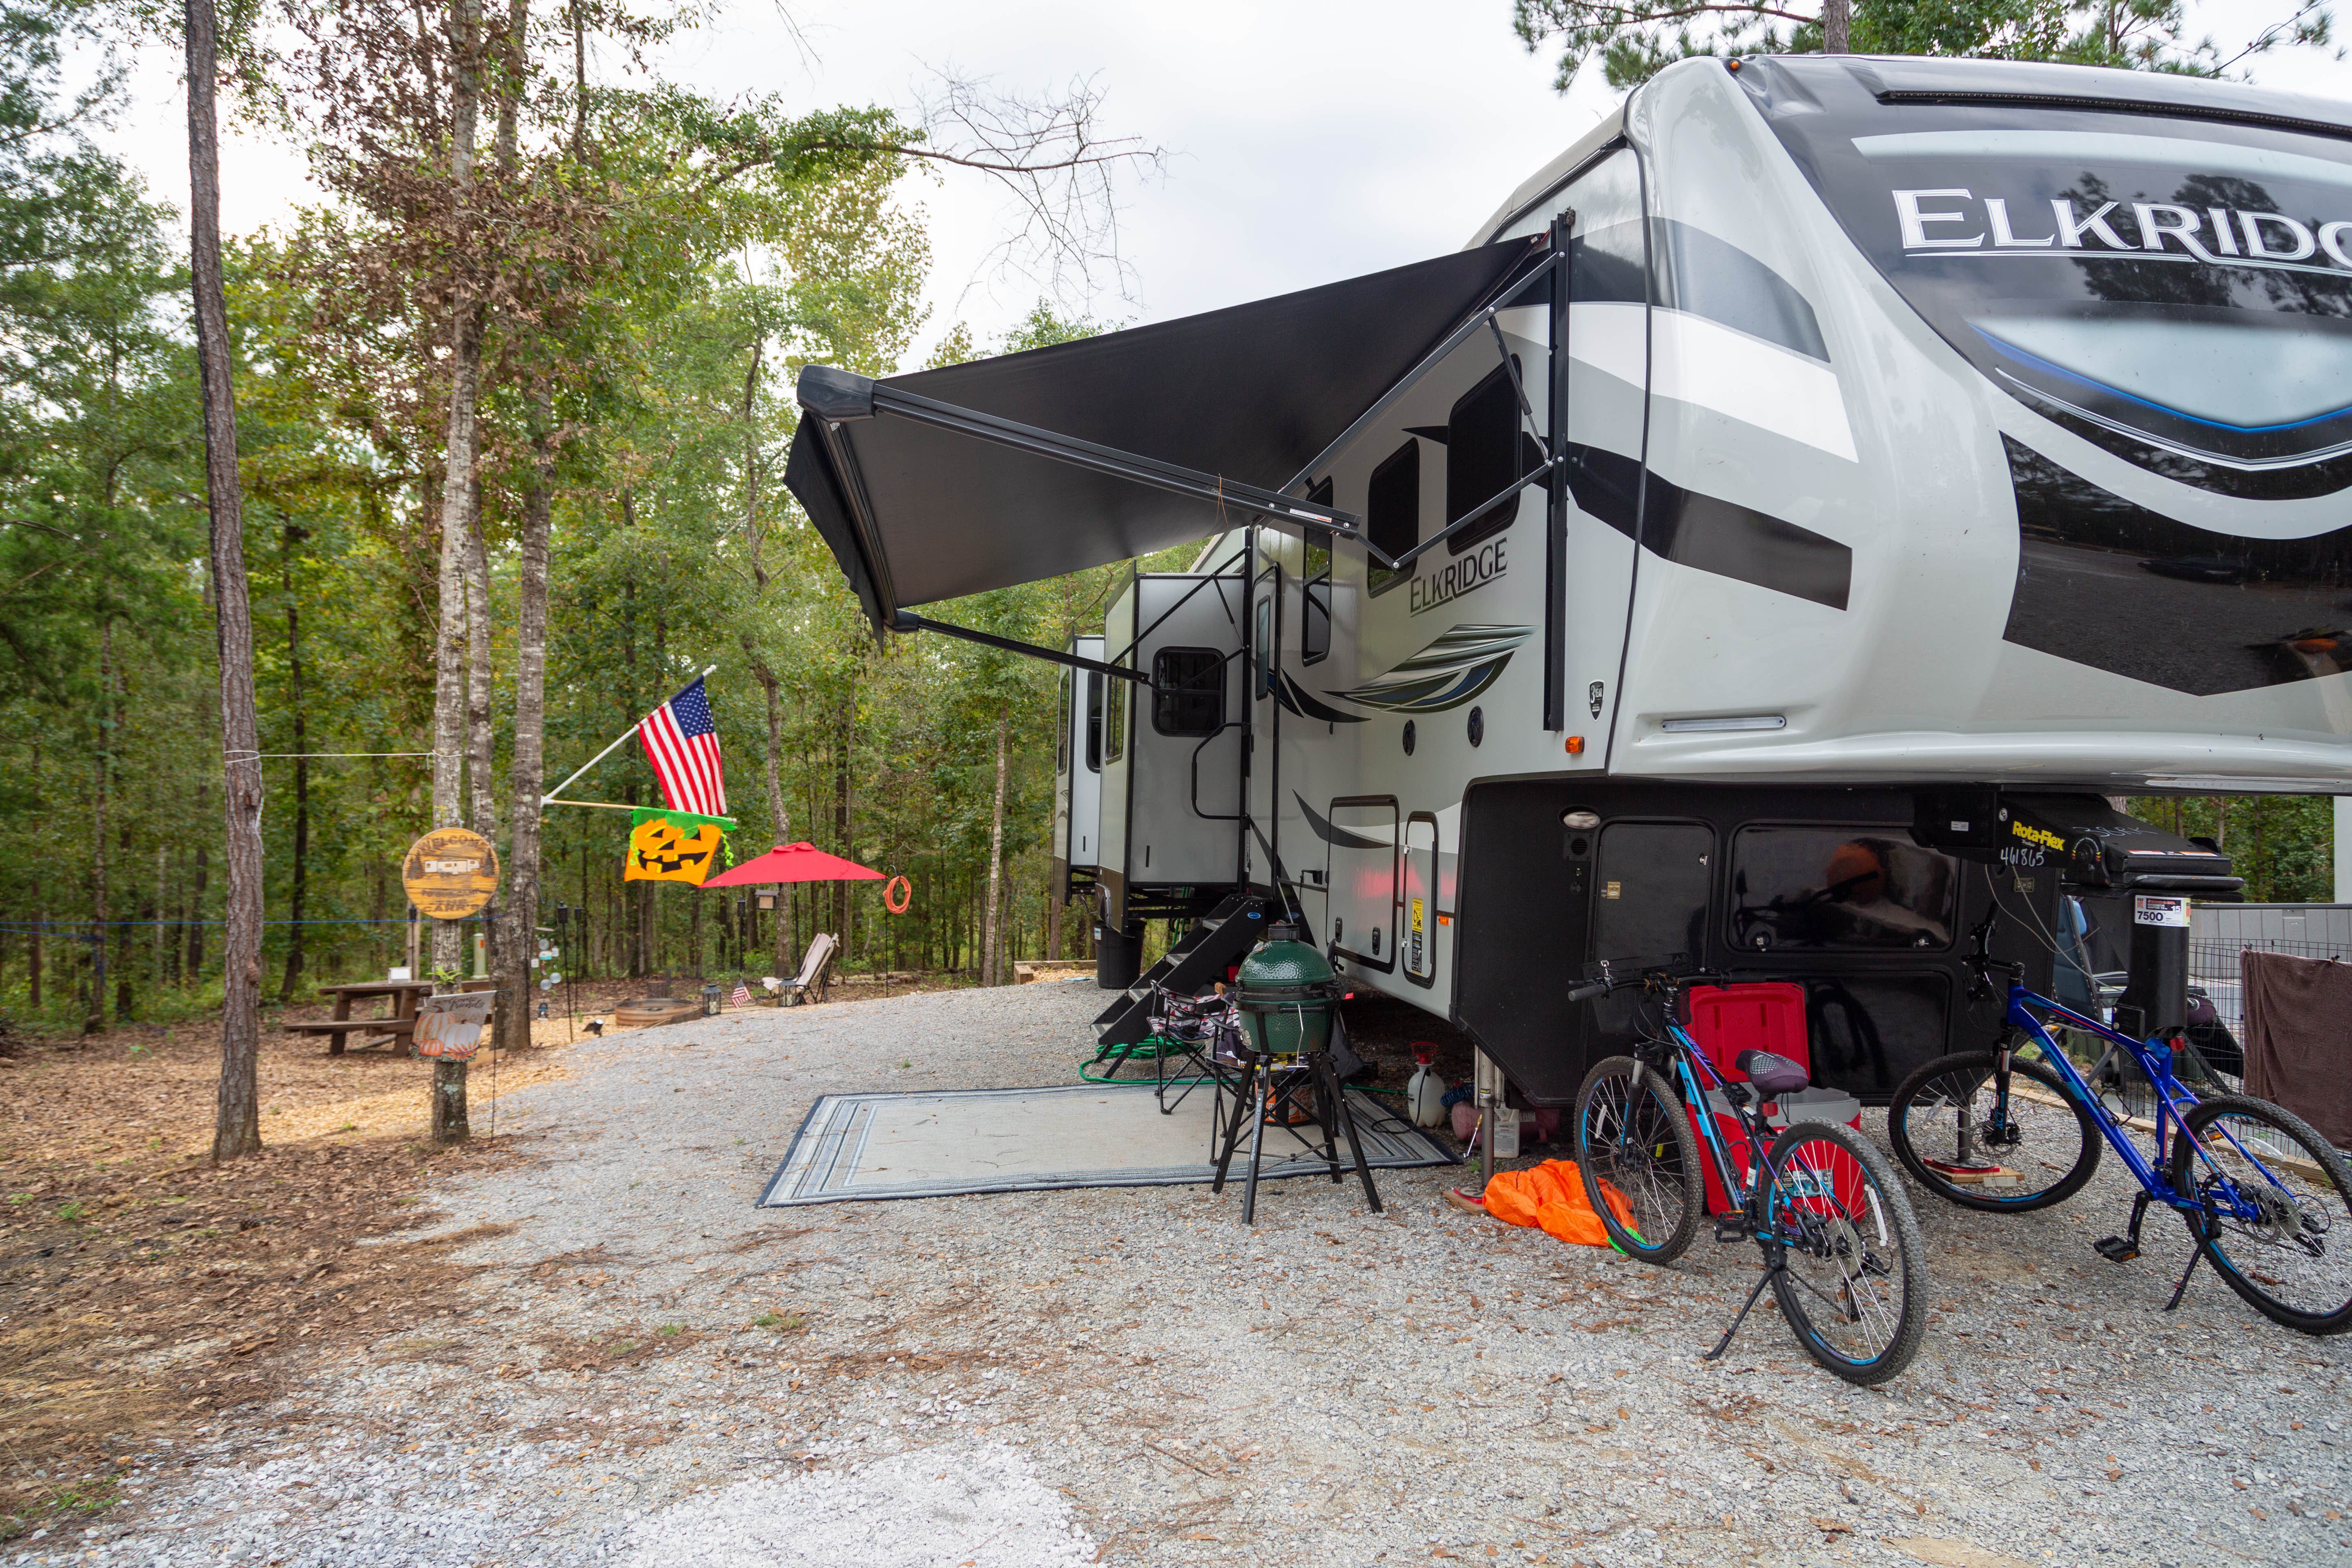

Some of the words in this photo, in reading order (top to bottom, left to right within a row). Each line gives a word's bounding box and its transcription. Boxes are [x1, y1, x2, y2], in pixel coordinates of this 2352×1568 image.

[1410, 537, 1508, 614] ELKRIDGE
[1590, 685, 1595, 704] 3
[2000, 846, 2045, 867] 461865
[2137, 911, 2164, 922] 7500
[434, 997, 478, 1005] welcome
[448, 1000, 485, 1011] friends
